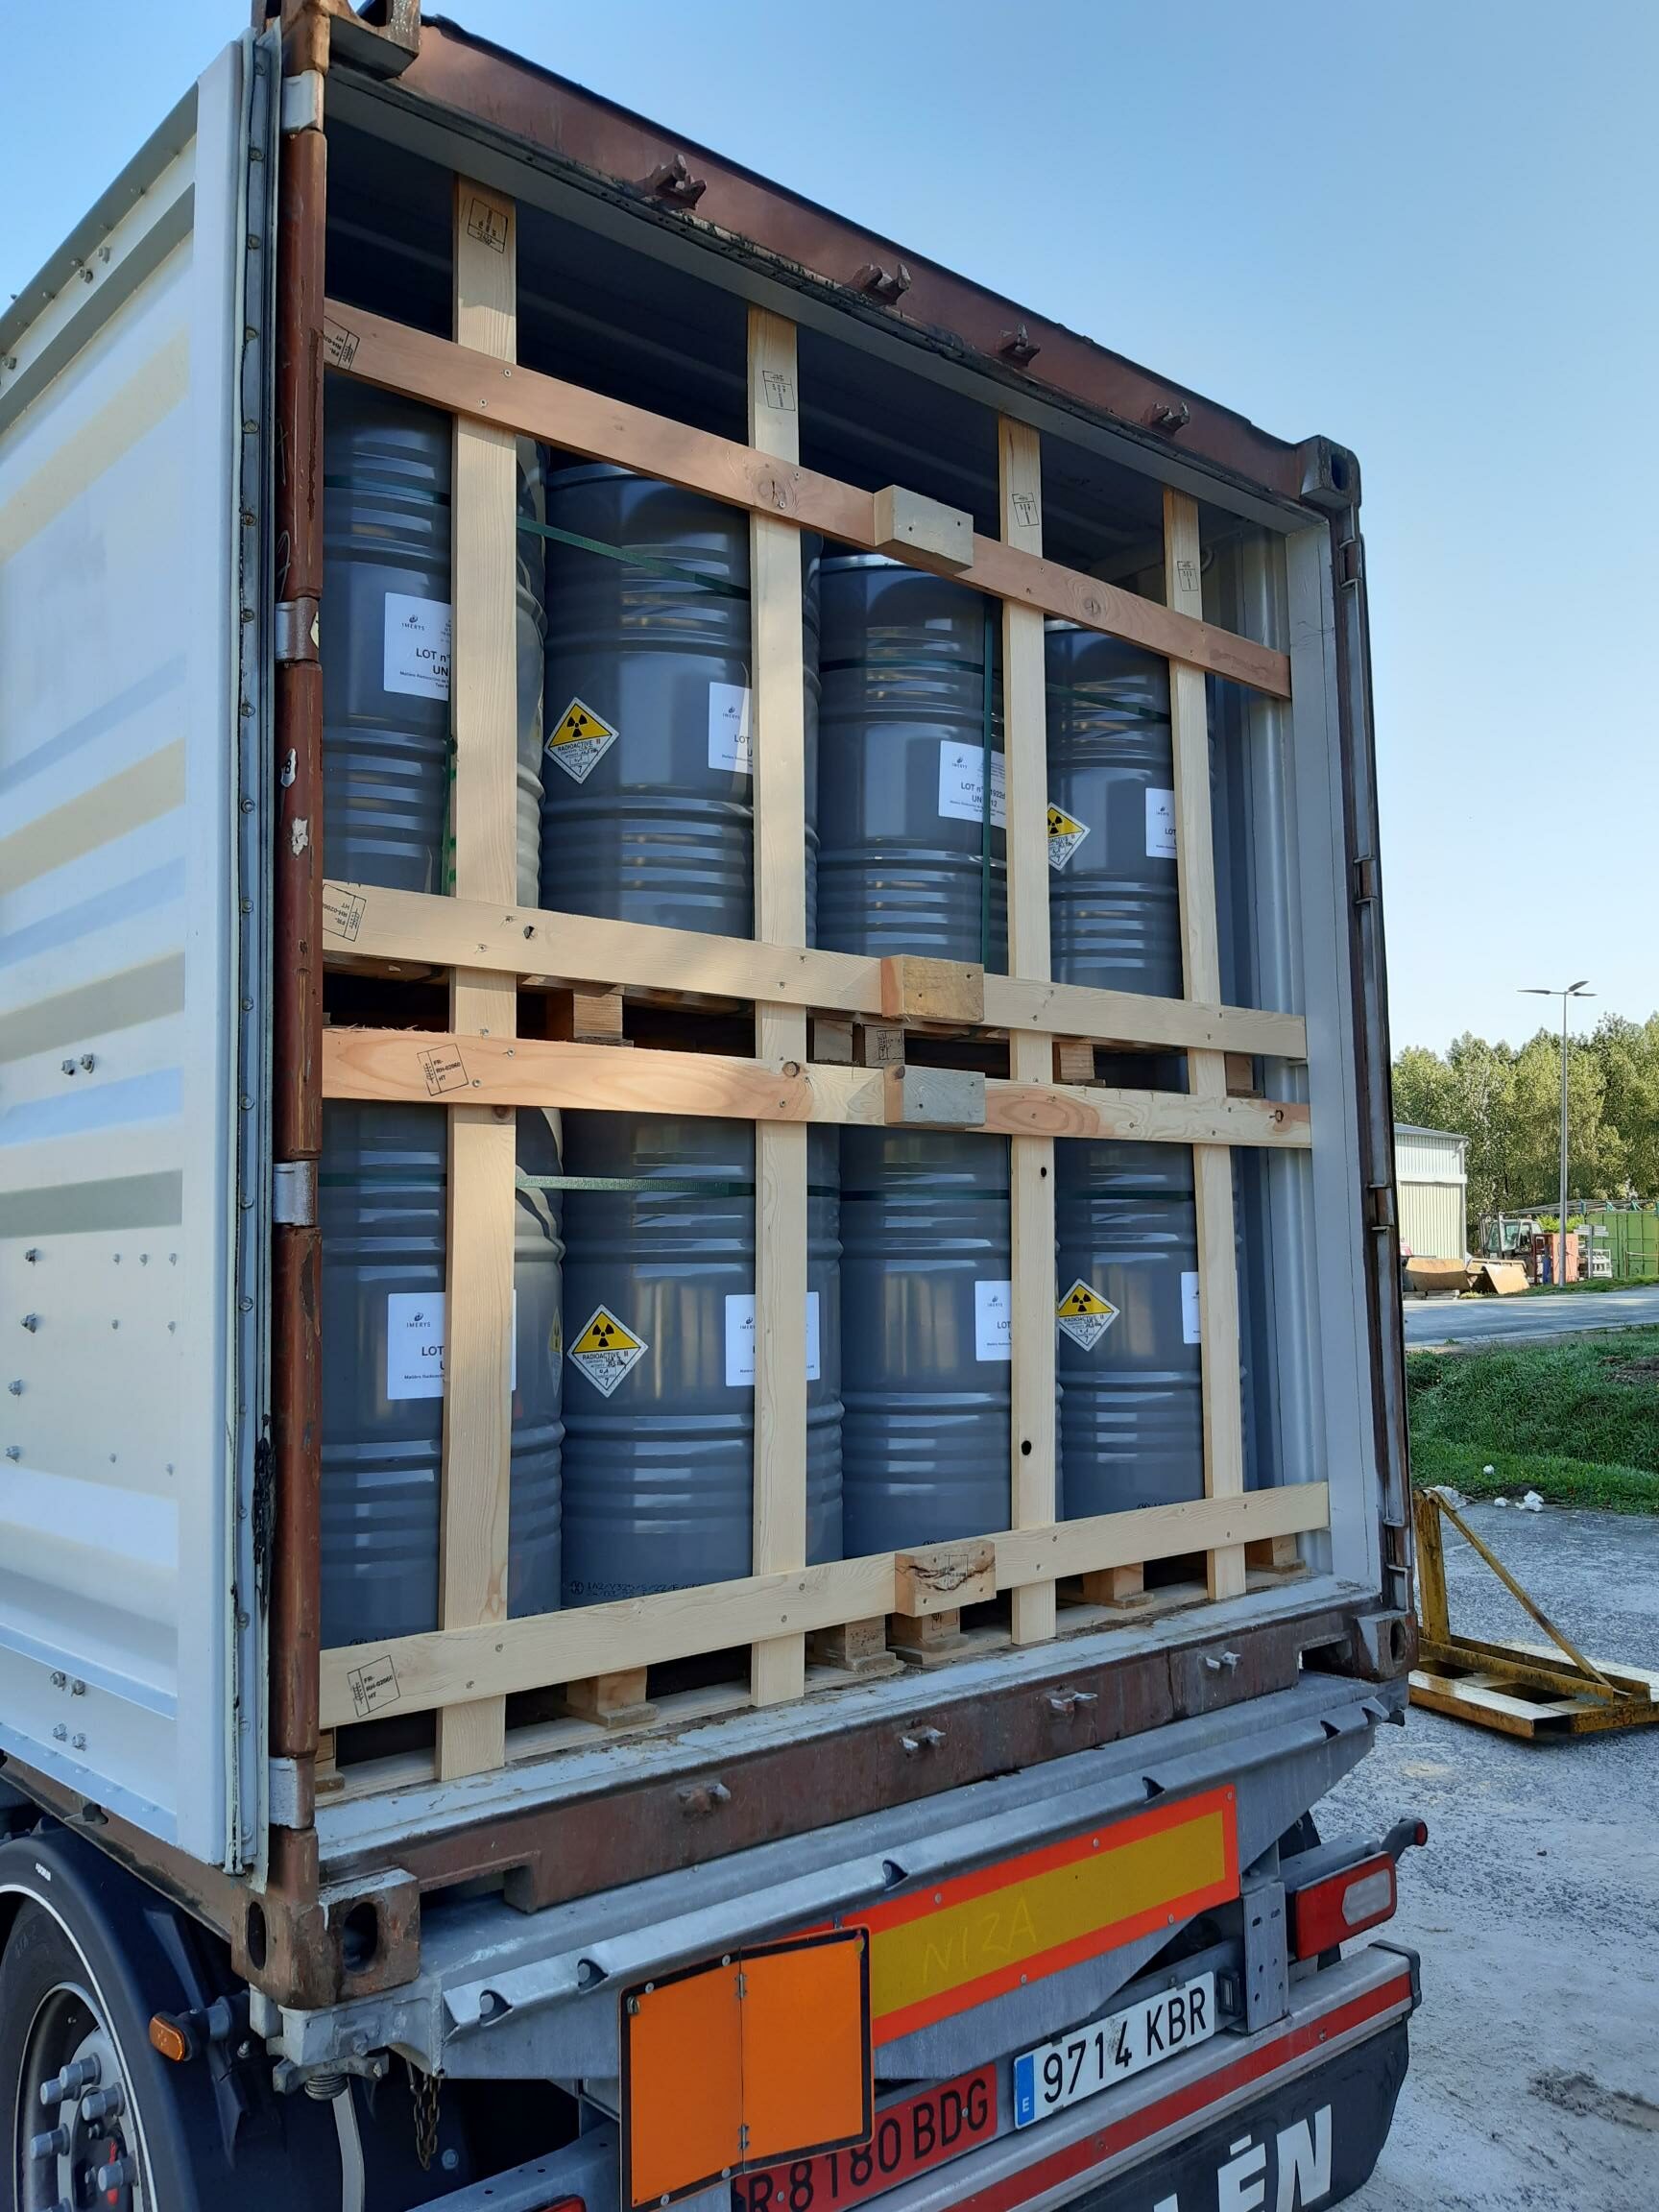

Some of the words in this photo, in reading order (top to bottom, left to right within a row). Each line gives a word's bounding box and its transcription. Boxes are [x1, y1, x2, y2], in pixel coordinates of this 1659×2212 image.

[416, 647, 437, 661] LOT
[432, 664, 448, 677] UN
[557, 739, 593, 752] RADIOACTIVE
[734, 734, 750, 745] LOT
[961, 781, 975, 792] LOT
[972, 794, 982, 804] UN
[997, 1320, 1011, 1330] LOT
[421, 1345, 445, 1357] LOT
[582, 1351, 620, 1360] RADIOACTIVE
[923, 1897, 1037, 1985] NIZA
[1043, 2020, 1133, 2104] 9714
[1146, 1986, 1207, 2056] KBR
[1022, 2096, 1030, 2113] E
[748, 2173, 774, 2212] R
[788, 2117, 902, 2212] 8180
[912, 2078, 988, 2160] BDG
